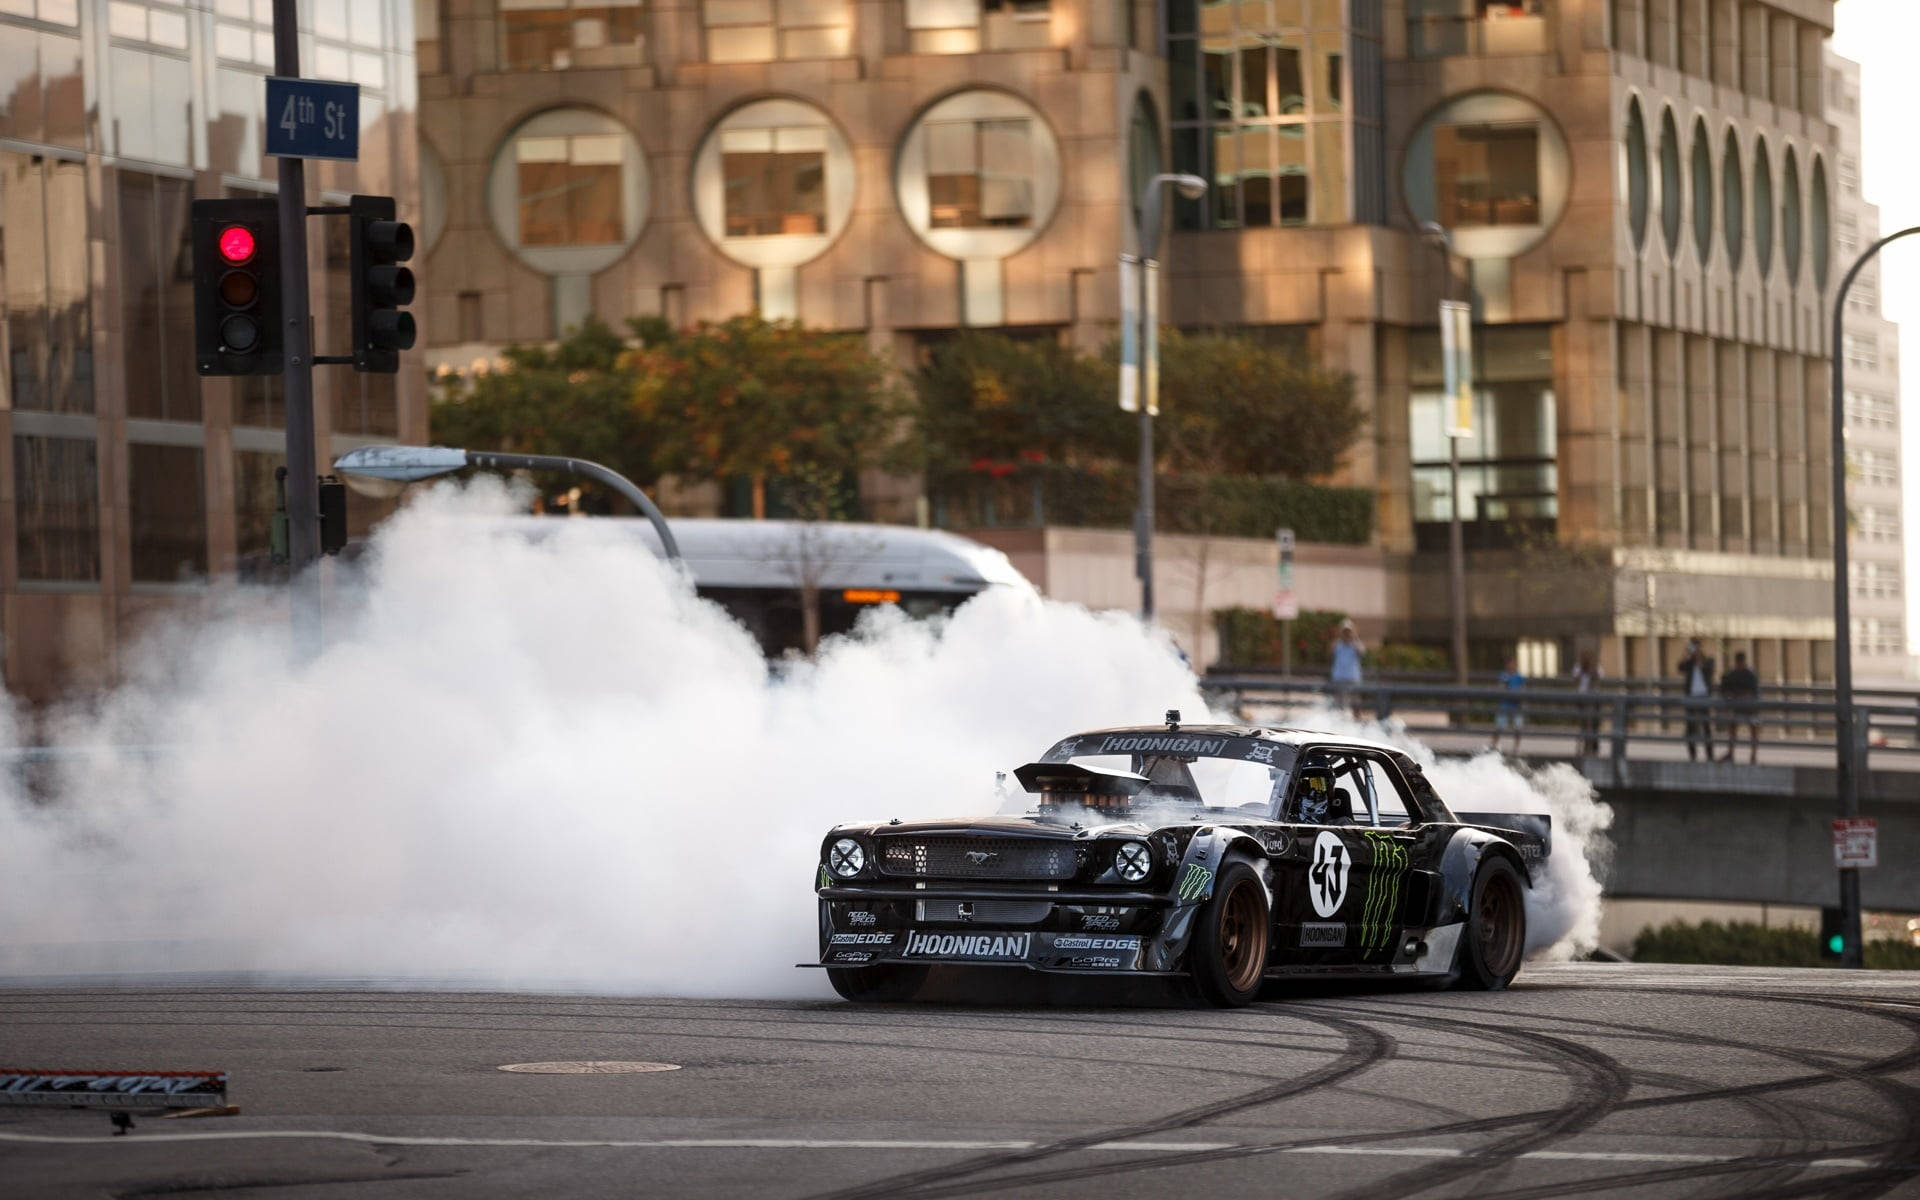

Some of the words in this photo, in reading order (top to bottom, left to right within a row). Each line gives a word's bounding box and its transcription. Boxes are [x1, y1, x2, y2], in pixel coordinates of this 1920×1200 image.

[280, 94, 315, 140] 4th
[323, 101, 346, 139] St
[856, 934, 895, 944] EDGE
[1091, 939, 1139, 950] EDGE
